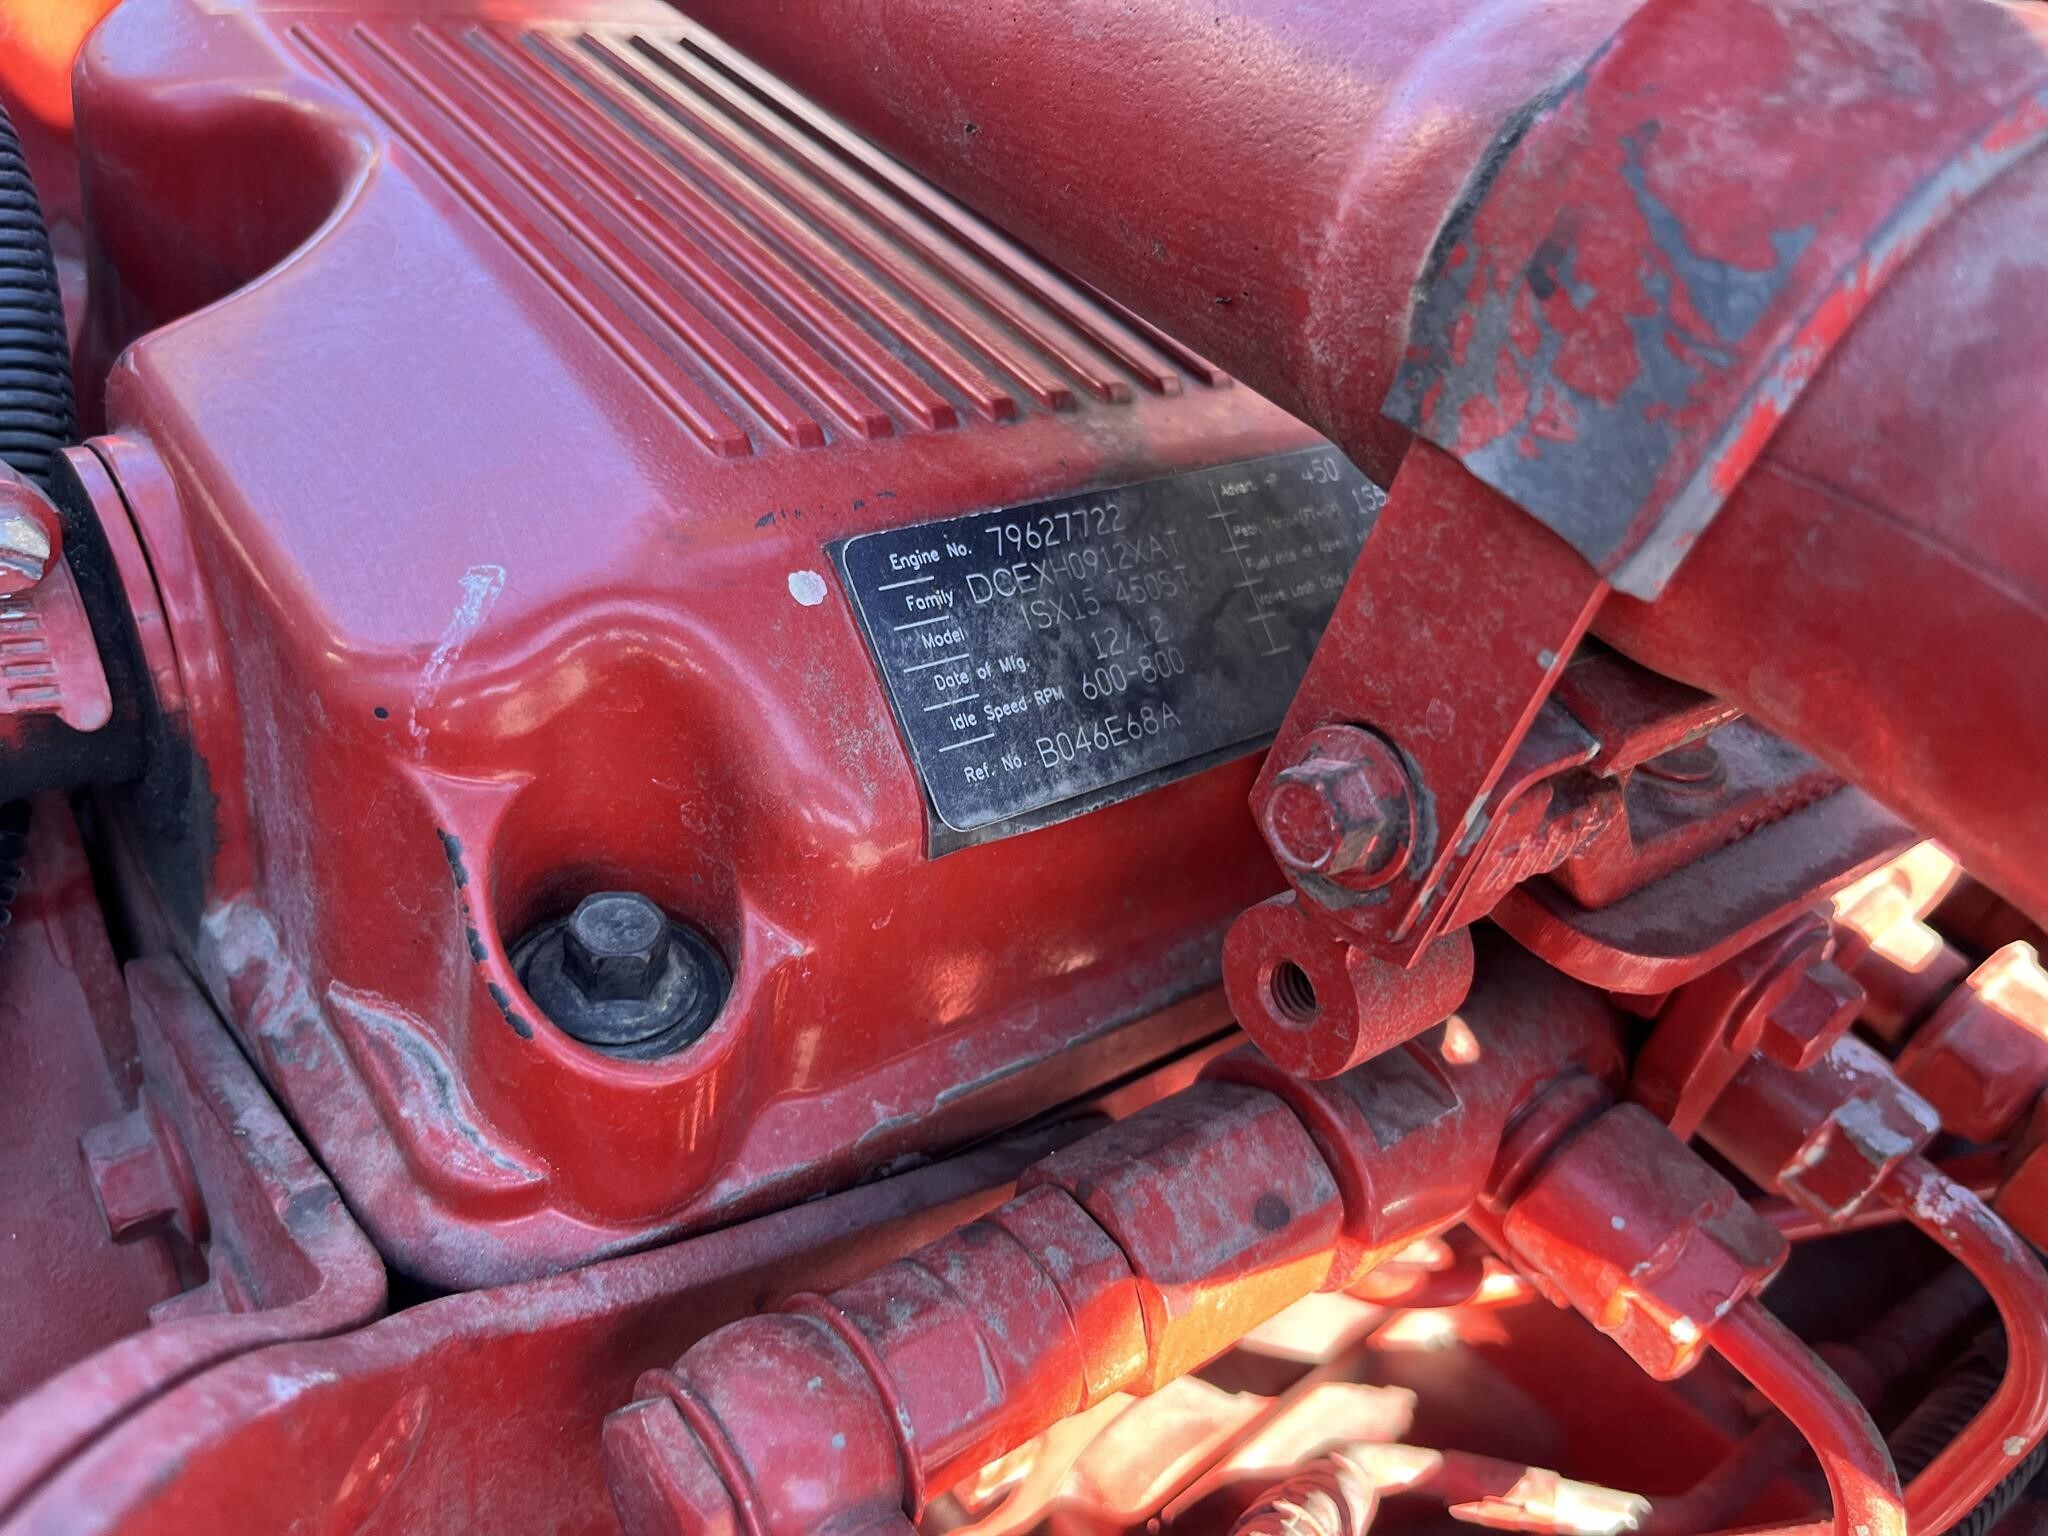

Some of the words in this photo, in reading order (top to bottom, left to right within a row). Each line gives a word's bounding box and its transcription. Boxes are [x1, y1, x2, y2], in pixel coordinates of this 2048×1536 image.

[1301, 456, 1341, 484] 450
[985, 504, 1126, 557] 79627722
[889, 547, 940, 574] Engine
[946, 540, 972, 560] No.
[965, 530, 1182, 605] DCEXH0912XAT
[905, 588, 954, 613] Family
[1020, 587, 1100, 631] ISX15
[1115, 565, 1192, 606] 450ST
[921, 627, 966, 650] Model
[1090, 615, 1170, 661] 12/12
[933, 668, 970, 692] Date
[977, 662, 993, 681] of
[999, 654, 1031, 676] Mfg.
[1081, 647, 1186, 701] 600-800
[949, 713, 978, 732] Idle
[983, 697, 1029, 724] Speed
[1033, 684, 1066, 708] RPM
[1035, 700, 1182, 769] B046E68A
[963, 762, 996, 784] Ref.
[1001, 751, 1028, 773] No.
